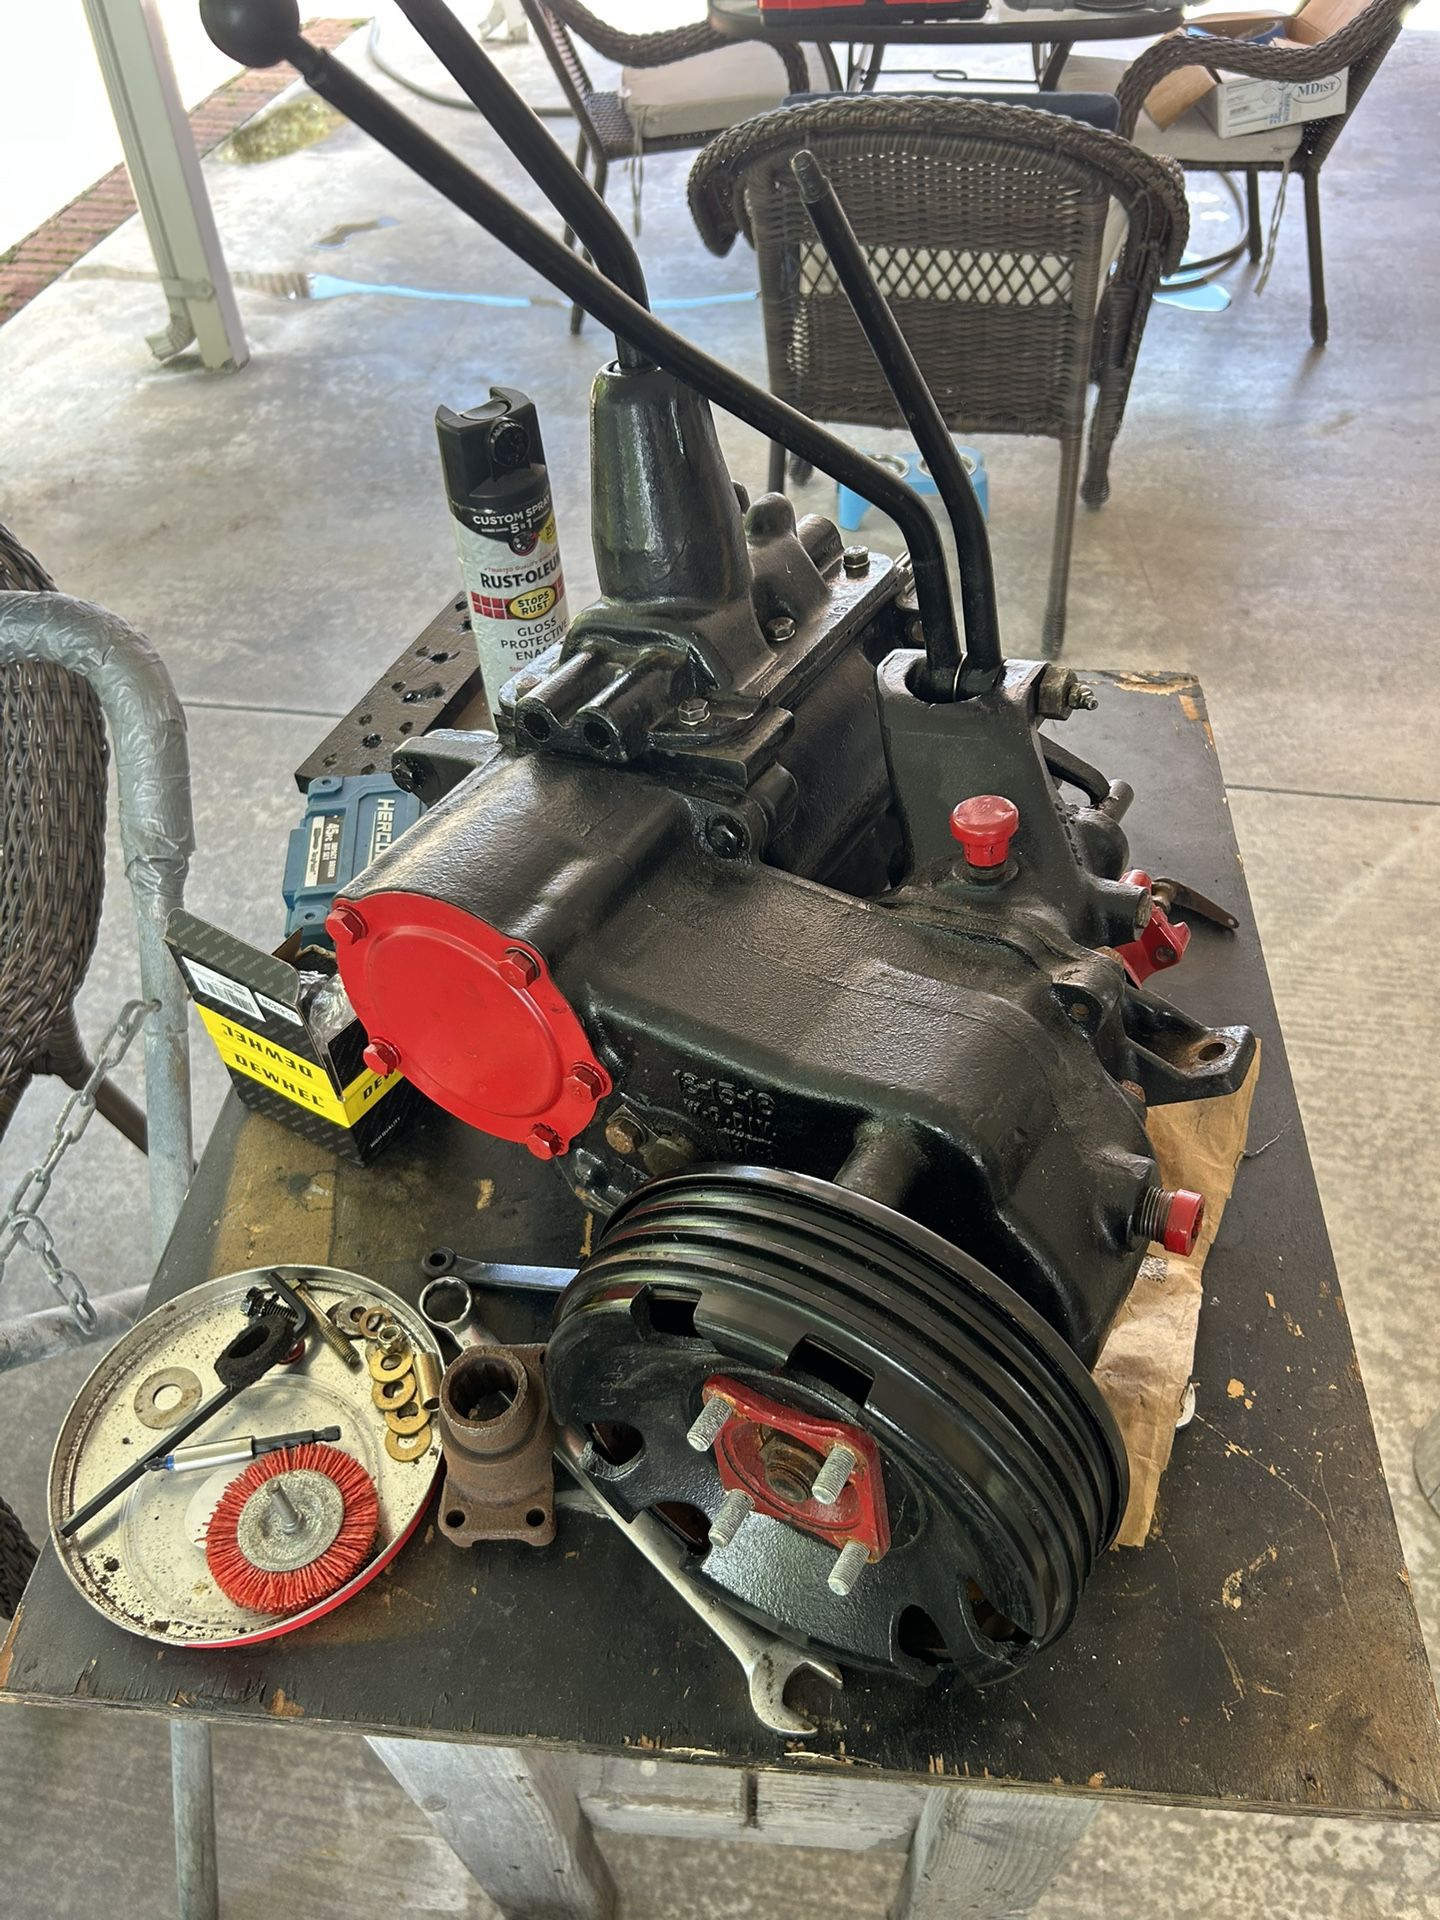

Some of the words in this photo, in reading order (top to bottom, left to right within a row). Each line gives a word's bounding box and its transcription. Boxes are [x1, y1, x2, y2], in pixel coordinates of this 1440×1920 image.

[472, 511, 524, 525] CUSTOM
[510, 522, 520, 534] 5
[526, 518, 533, 529] 1
[517, 590, 550, 608] STOPS
[521, 600, 548, 616] RUST
[500, 617, 568, 649] PROTECTIVE
[517, 615, 557, 637] GLOSS
[515, 644, 551, 661] ENA
[375, 798, 396, 855] HERCU
[221, 1022, 314, 1079] DEWHEL
[234, 1053, 325, 1109] DEWHEL
